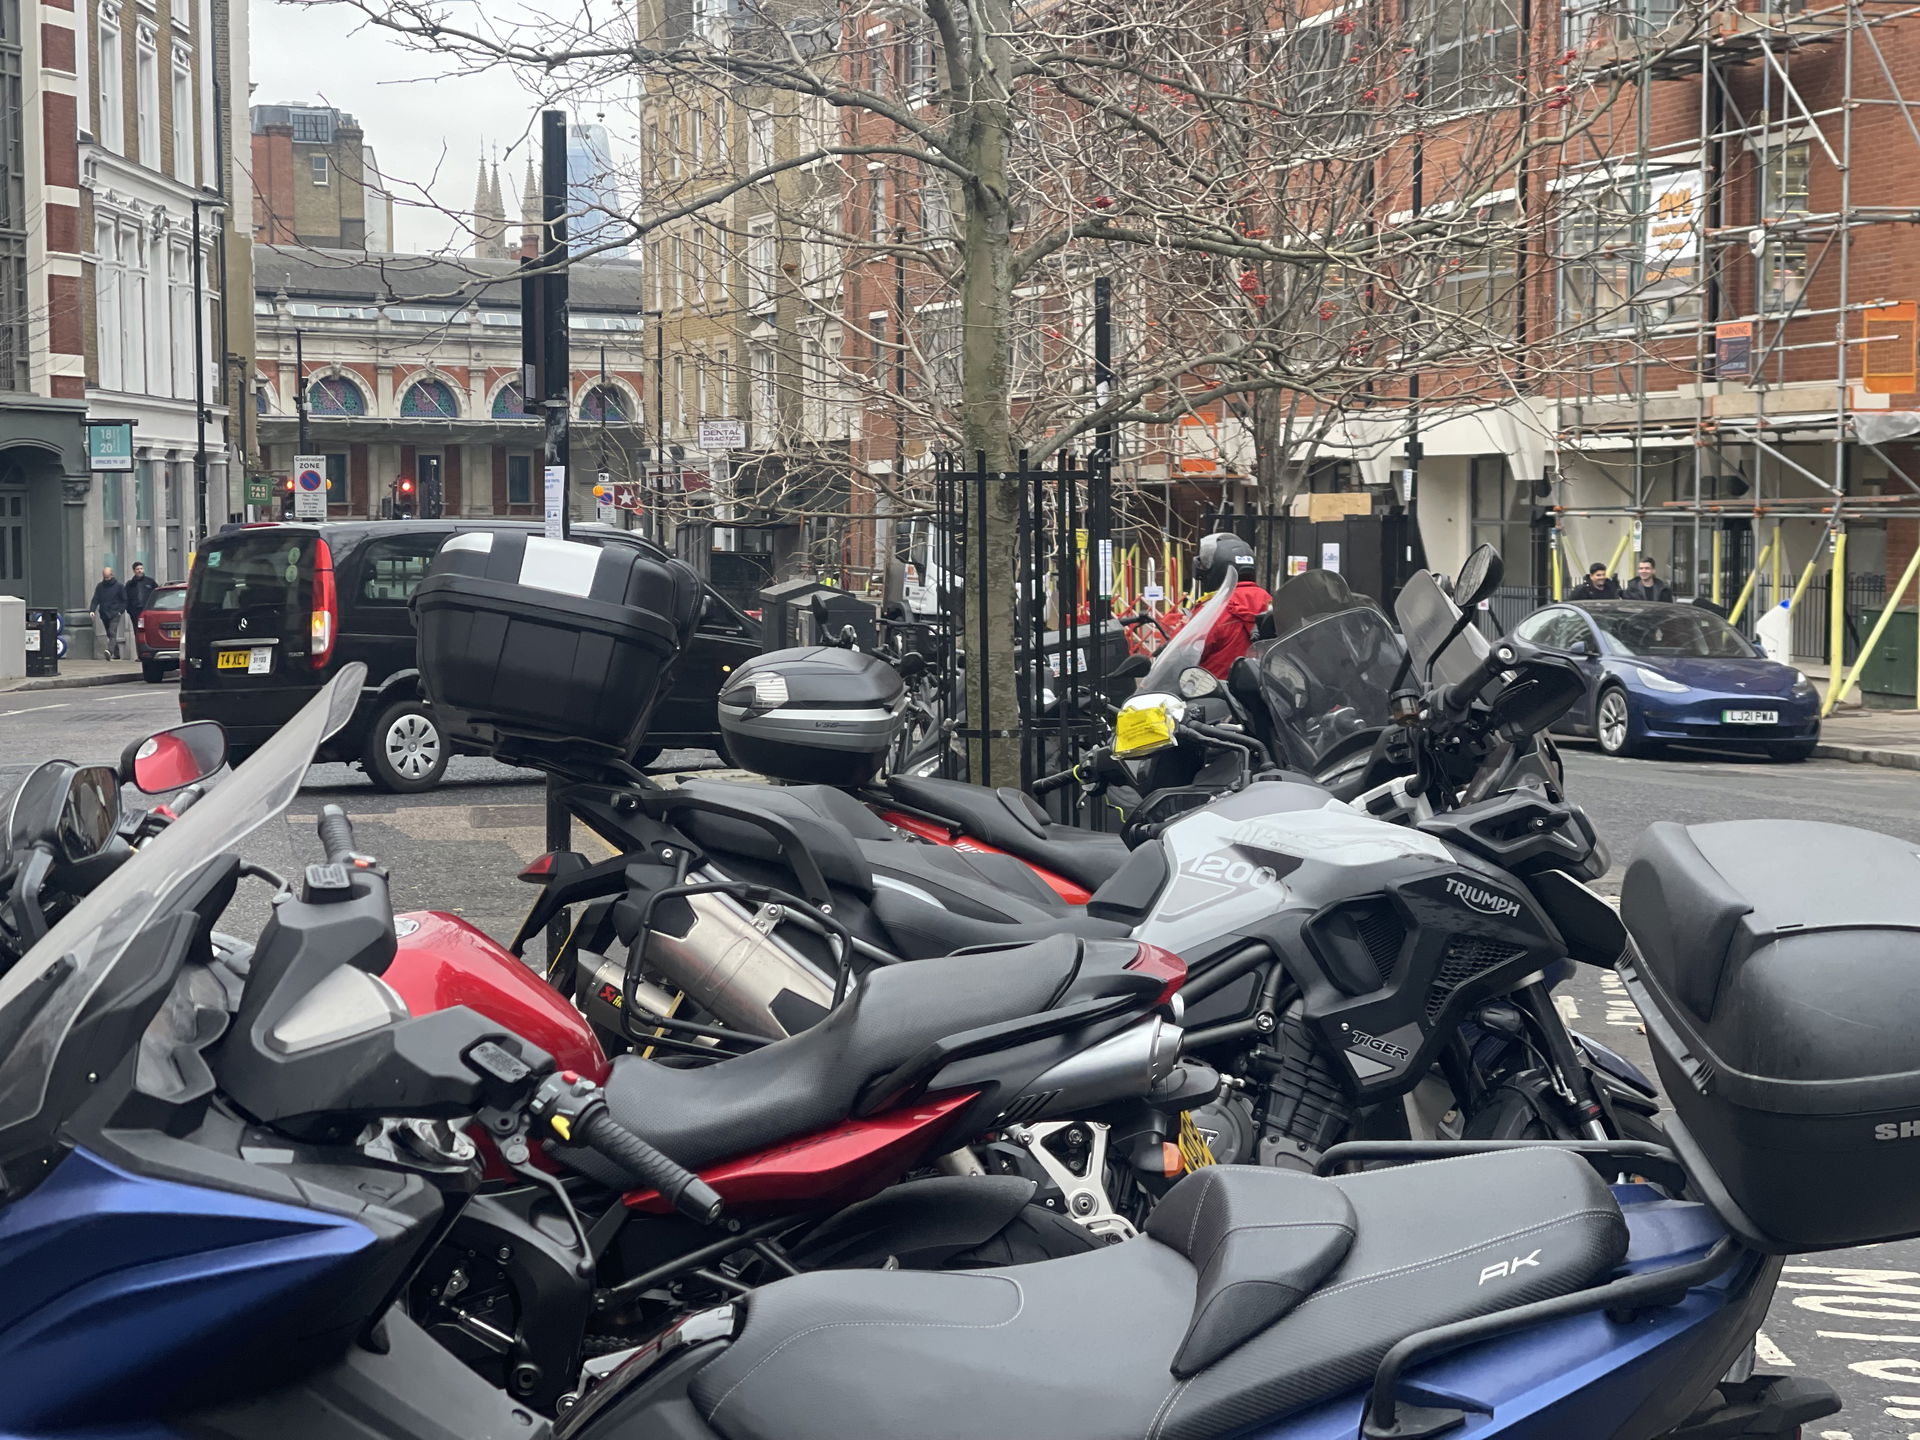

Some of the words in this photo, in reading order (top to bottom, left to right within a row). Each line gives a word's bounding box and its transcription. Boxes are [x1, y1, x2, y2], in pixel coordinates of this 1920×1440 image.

[100, 429, 112, 440] 18
[100, 443, 113, 453] 20
[1188, 855, 1277, 887] 1200
[1446, 877, 1520, 918] TRIUMPH
[1351, 1029, 1409, 1062] TIGER
[1478, 1248, 1542, 1286] AK
